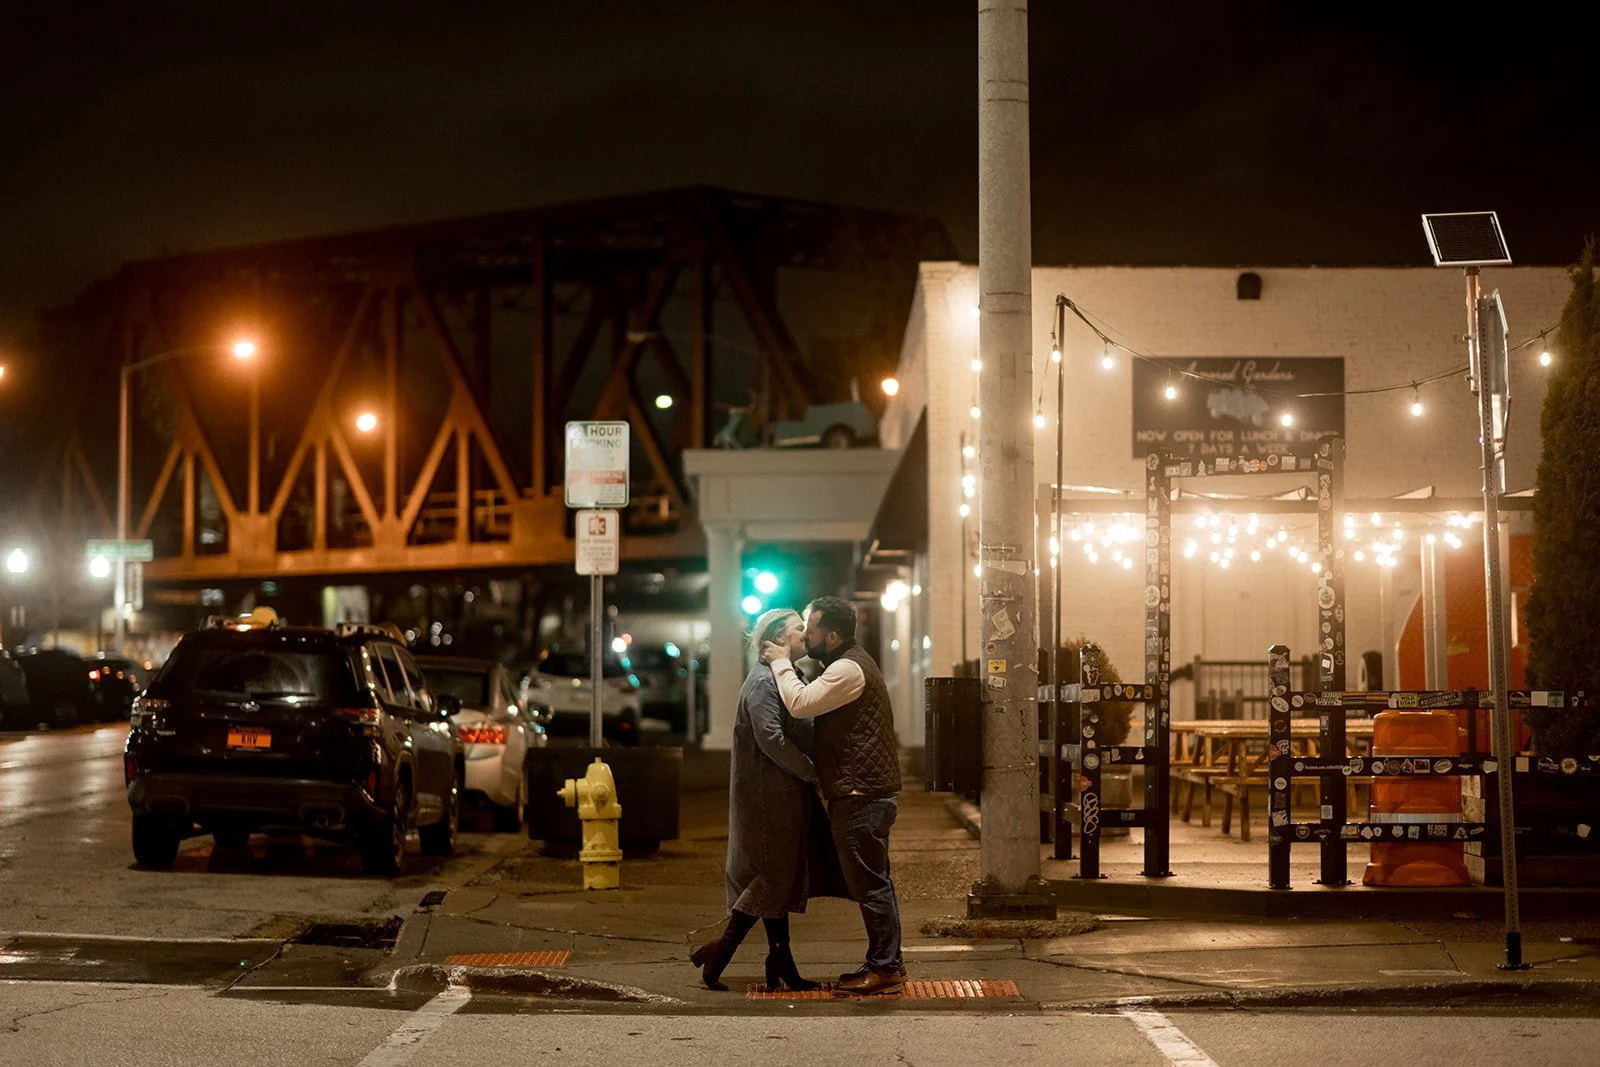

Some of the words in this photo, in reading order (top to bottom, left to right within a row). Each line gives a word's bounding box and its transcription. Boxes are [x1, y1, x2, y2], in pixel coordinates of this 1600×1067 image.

[590, 426, 622, 436] HOUR
[1136, 431, 1167, 441] NOW
[1173, 431, 1205, 441] OPEN
[1210, 431, 1234, 441] FOR
[1241, 431, 1281, 441] LUNCH
[1202, 443, 1233, 454] DAYS
[1241, 443, 1250, 454] A
[1257, 443, 1289, 454] WEEK
